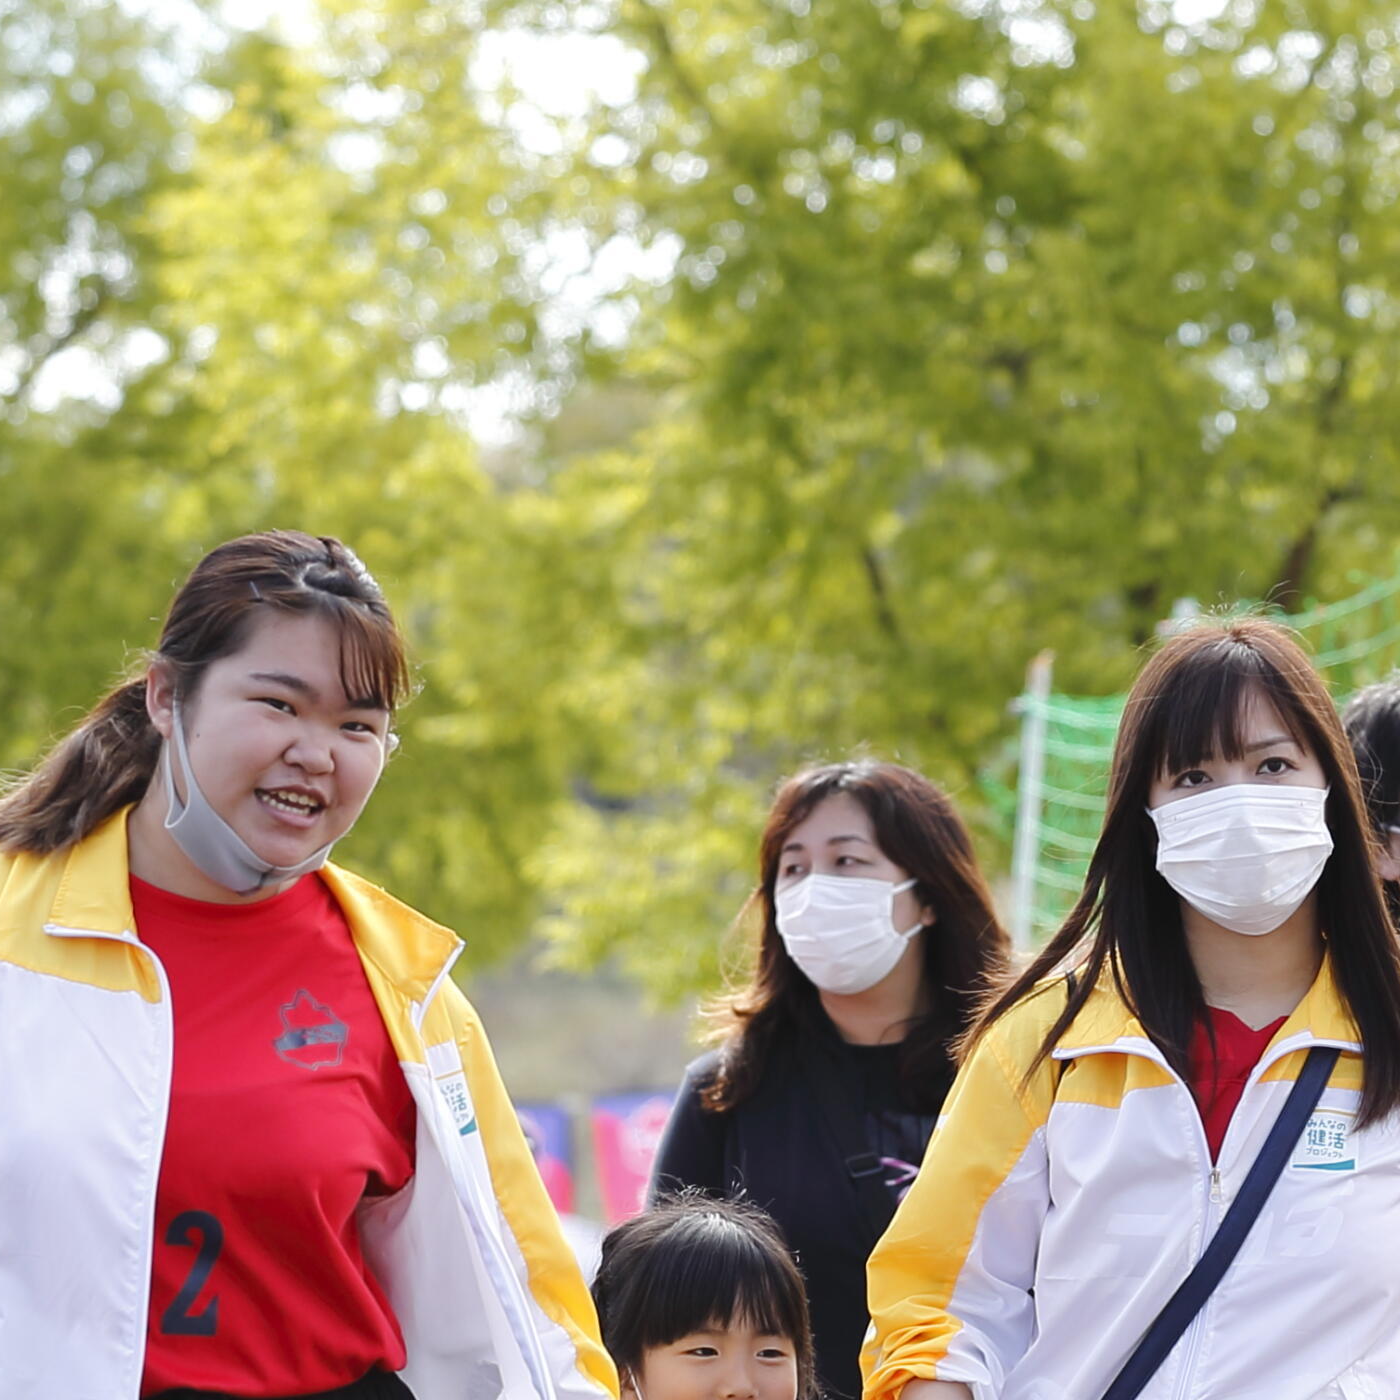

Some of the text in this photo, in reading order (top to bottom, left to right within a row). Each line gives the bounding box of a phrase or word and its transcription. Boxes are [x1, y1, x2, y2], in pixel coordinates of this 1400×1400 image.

[1306, 1117, 1346, 1131] みんなの
[1306, 1127, 1344, 1149] 健活
